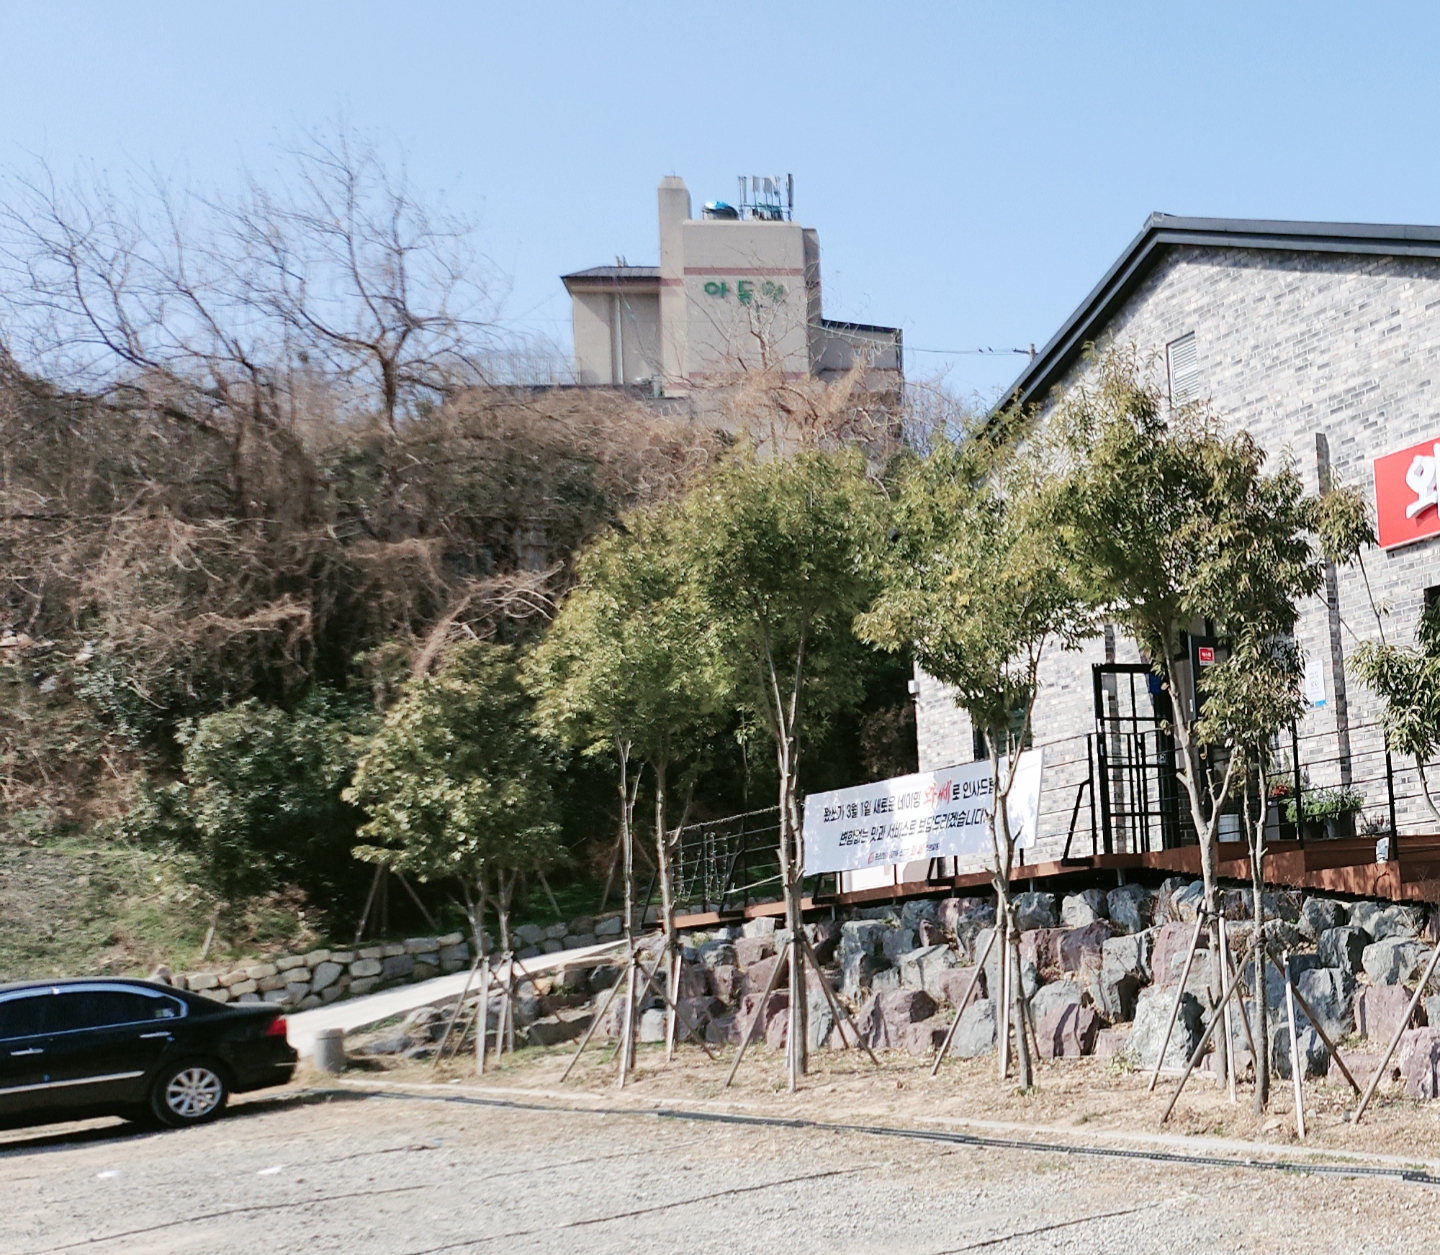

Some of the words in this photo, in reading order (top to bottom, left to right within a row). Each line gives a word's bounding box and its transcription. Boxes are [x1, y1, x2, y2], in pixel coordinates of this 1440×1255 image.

[846, 803, 858, 819] 3월
[860, 799, 872, 817] 1일
[873, 796, 896, 813] 새로운
[897, 790, 921, 810] 네이밍
[869, 825, 886, 842] 맛과
[887, 820, 917, 838] 서비스로
